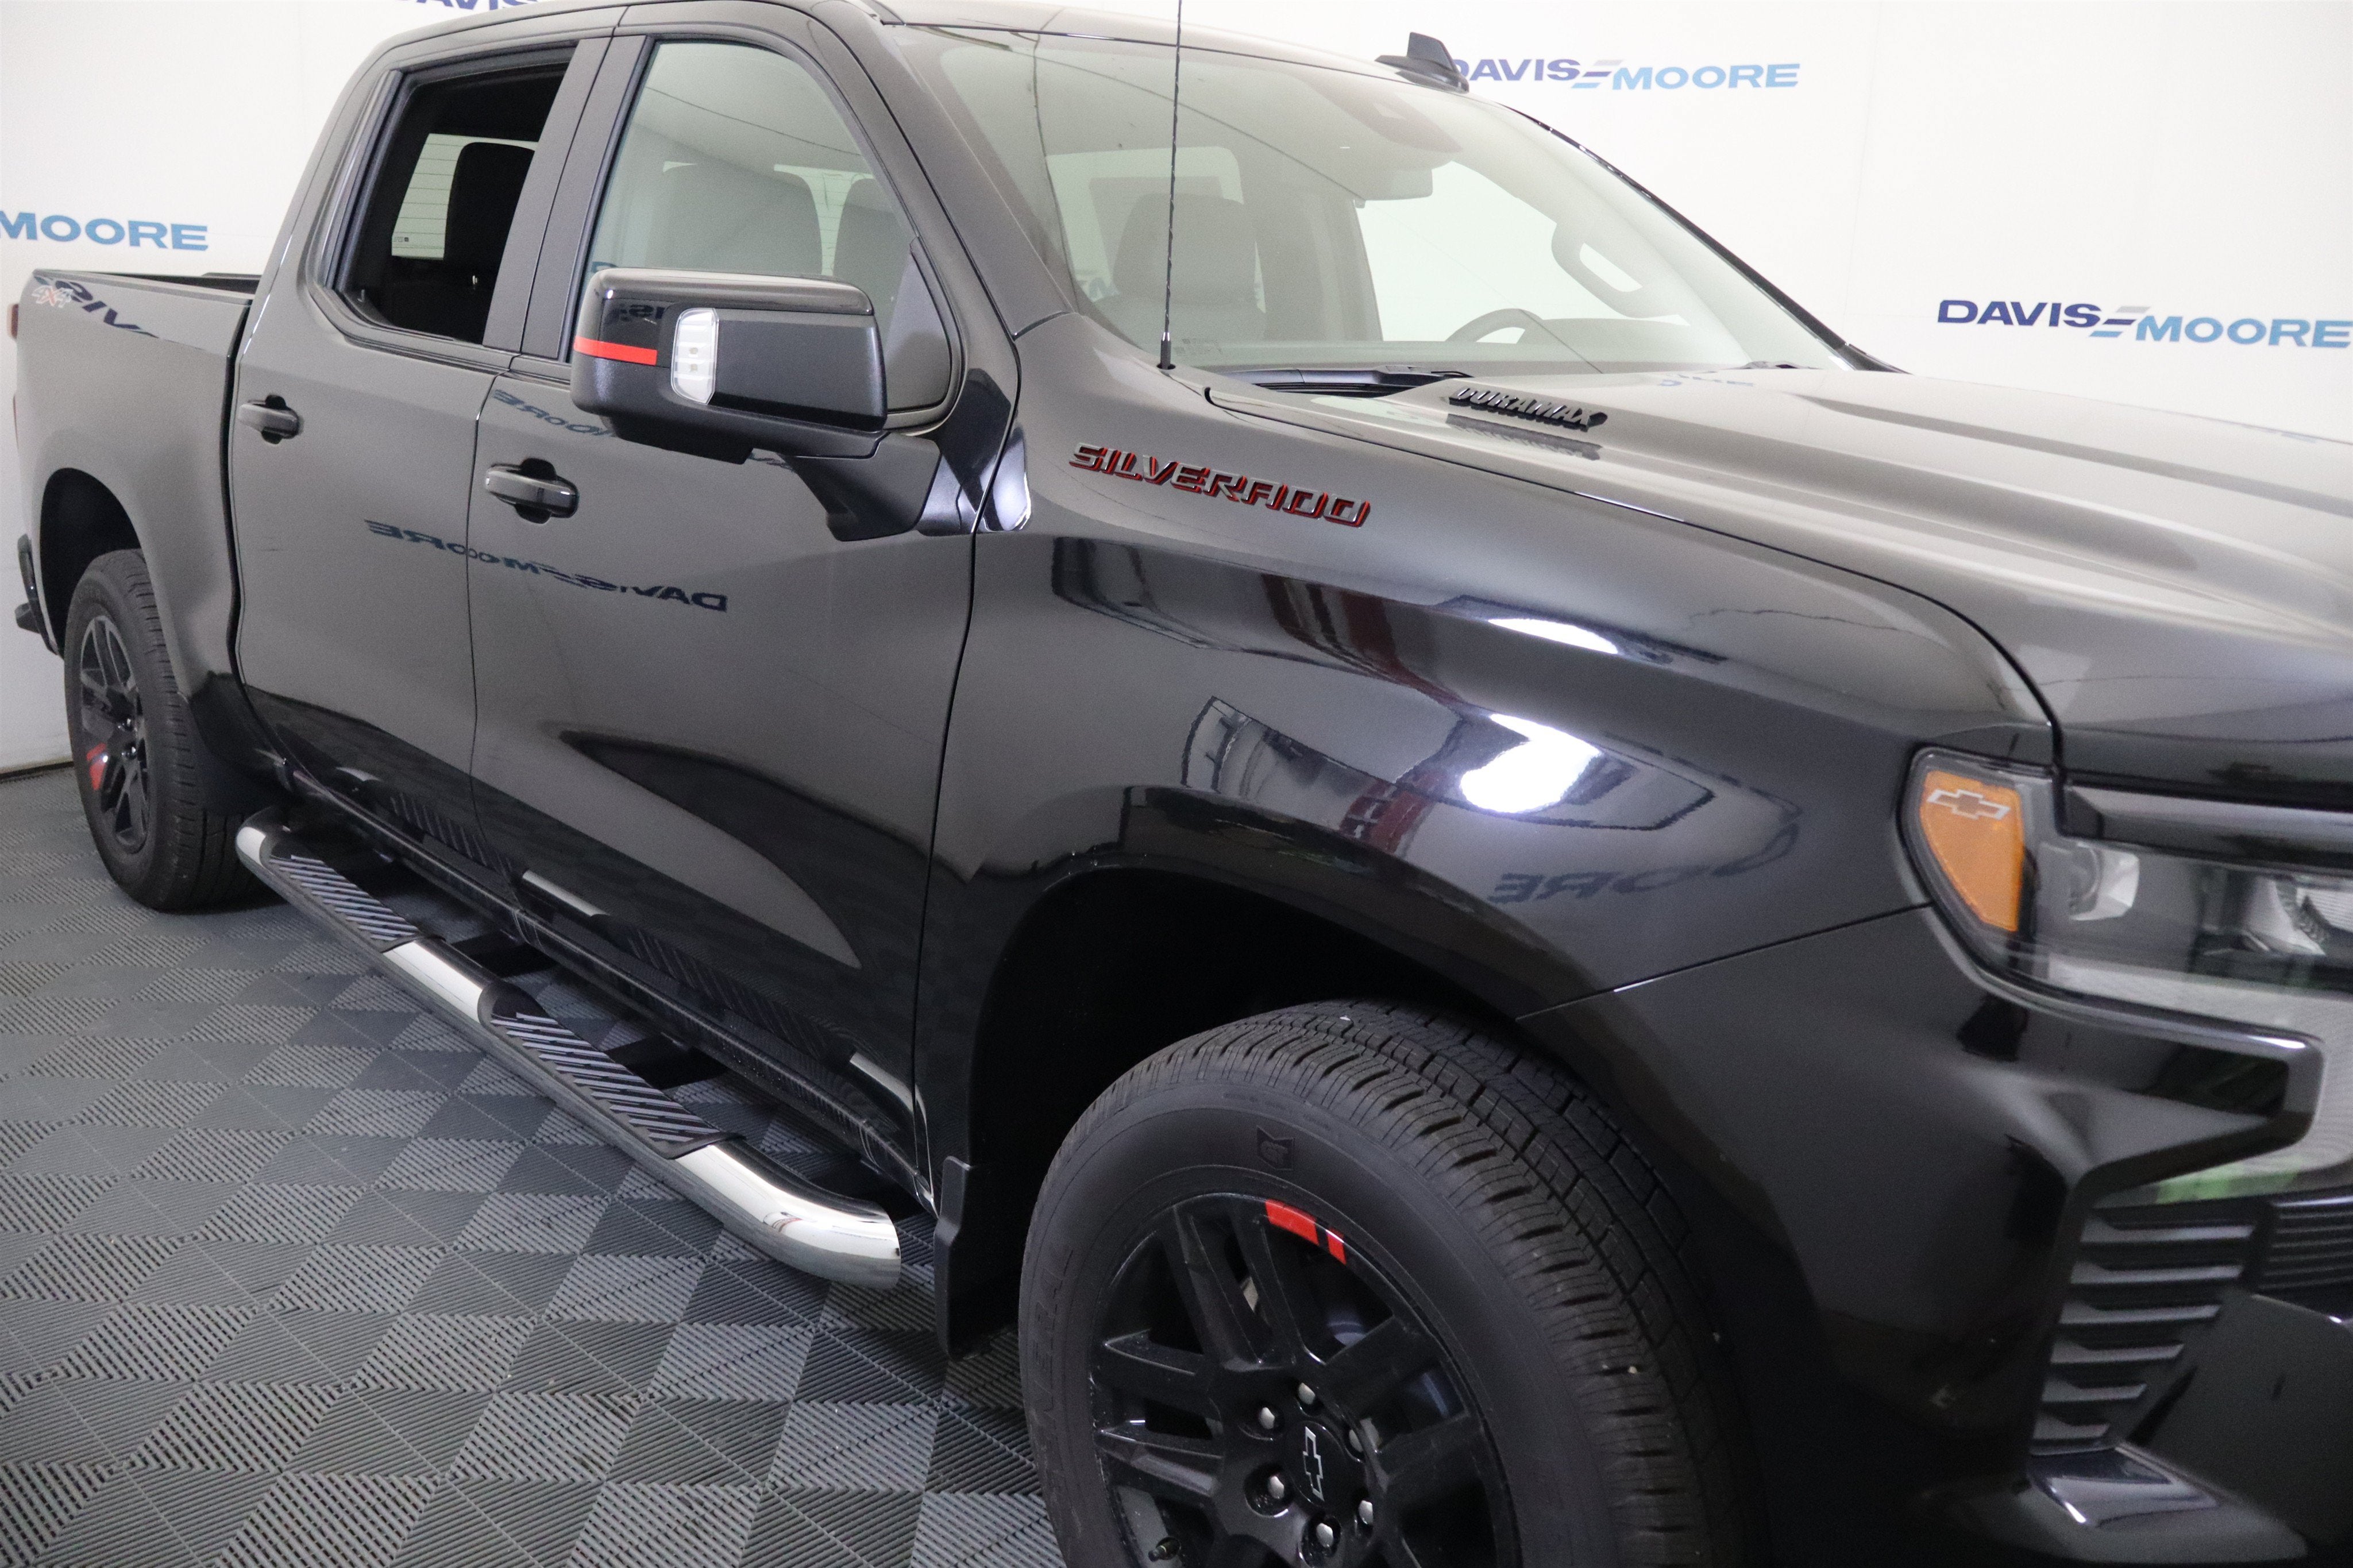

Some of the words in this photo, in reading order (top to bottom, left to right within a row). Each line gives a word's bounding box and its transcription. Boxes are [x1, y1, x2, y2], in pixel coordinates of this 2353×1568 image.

[1612, 64, 1800, 90] MOORE
[1938, 300, 2101, 327] DAVIS
[2136, 315, 2353, 348] MOORE
[1449, 387, 1608, 432] DURAMAX
[1069, 442, 1371, 528] SILVERADO
